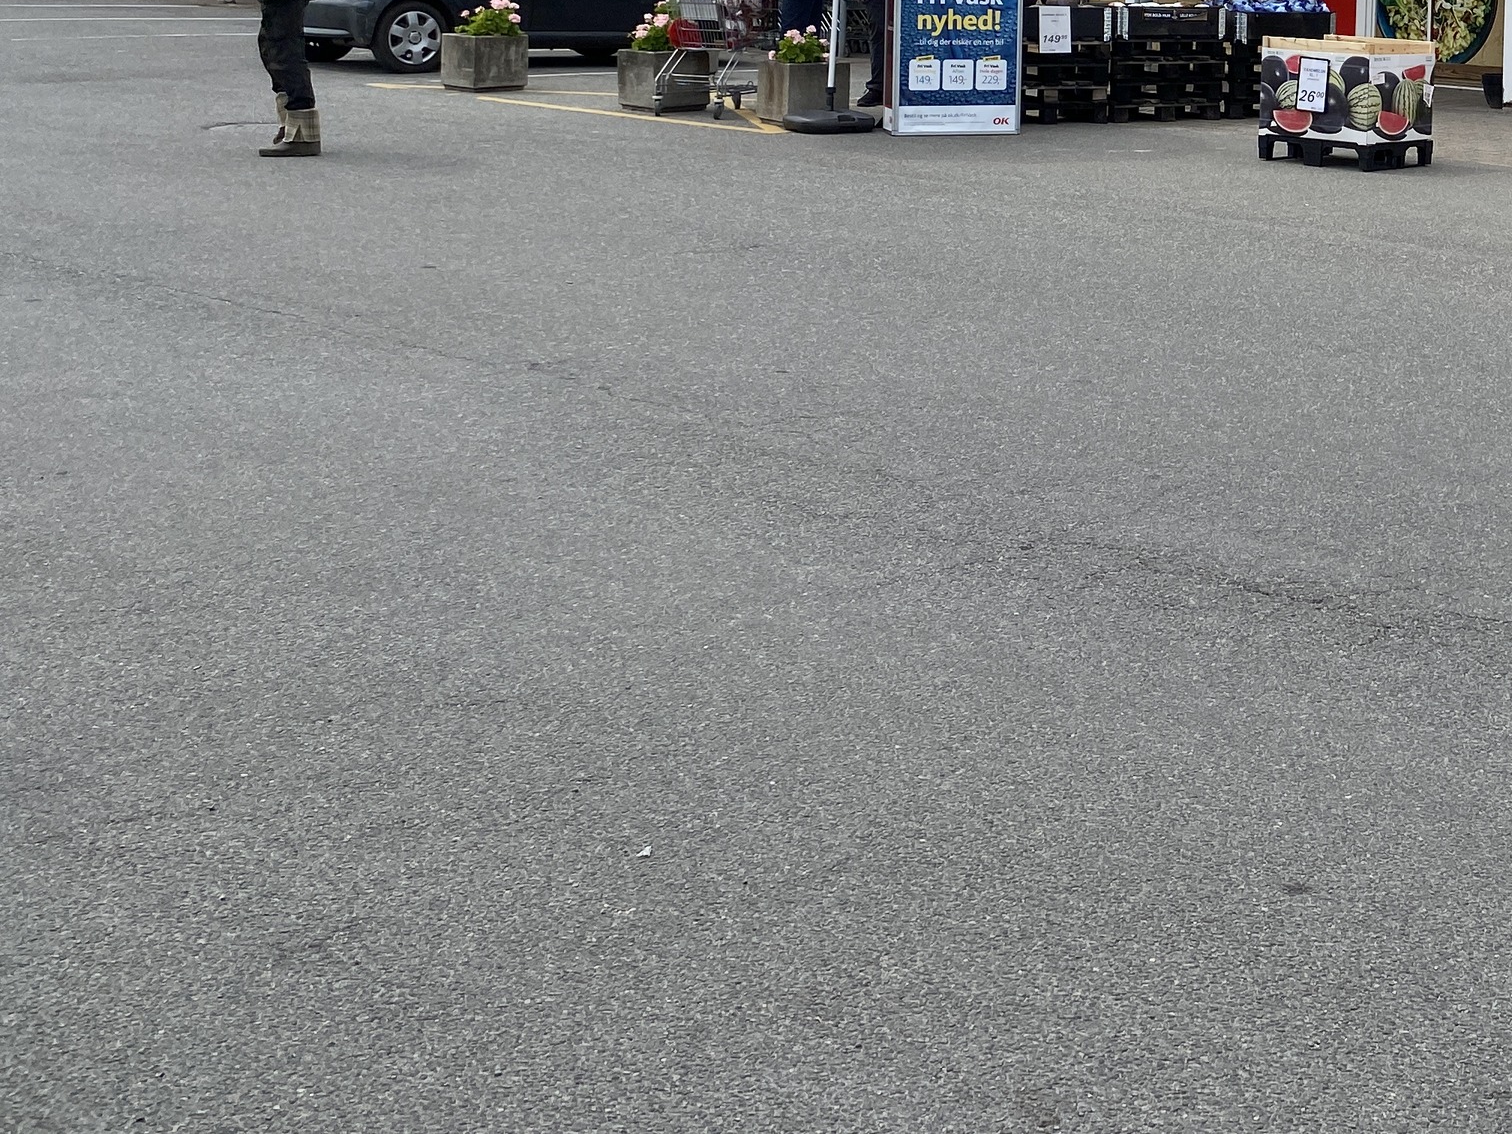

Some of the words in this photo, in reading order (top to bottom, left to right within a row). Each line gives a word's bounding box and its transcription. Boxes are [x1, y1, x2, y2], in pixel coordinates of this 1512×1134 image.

[917, 8, 1001, 37] nyhed!
[927, 38, 938, 47] dig
[1043, 34, 1061, 43] 149
[1299, 89, 1316, 103] 26
[993, 117, 1010, 125] OK
